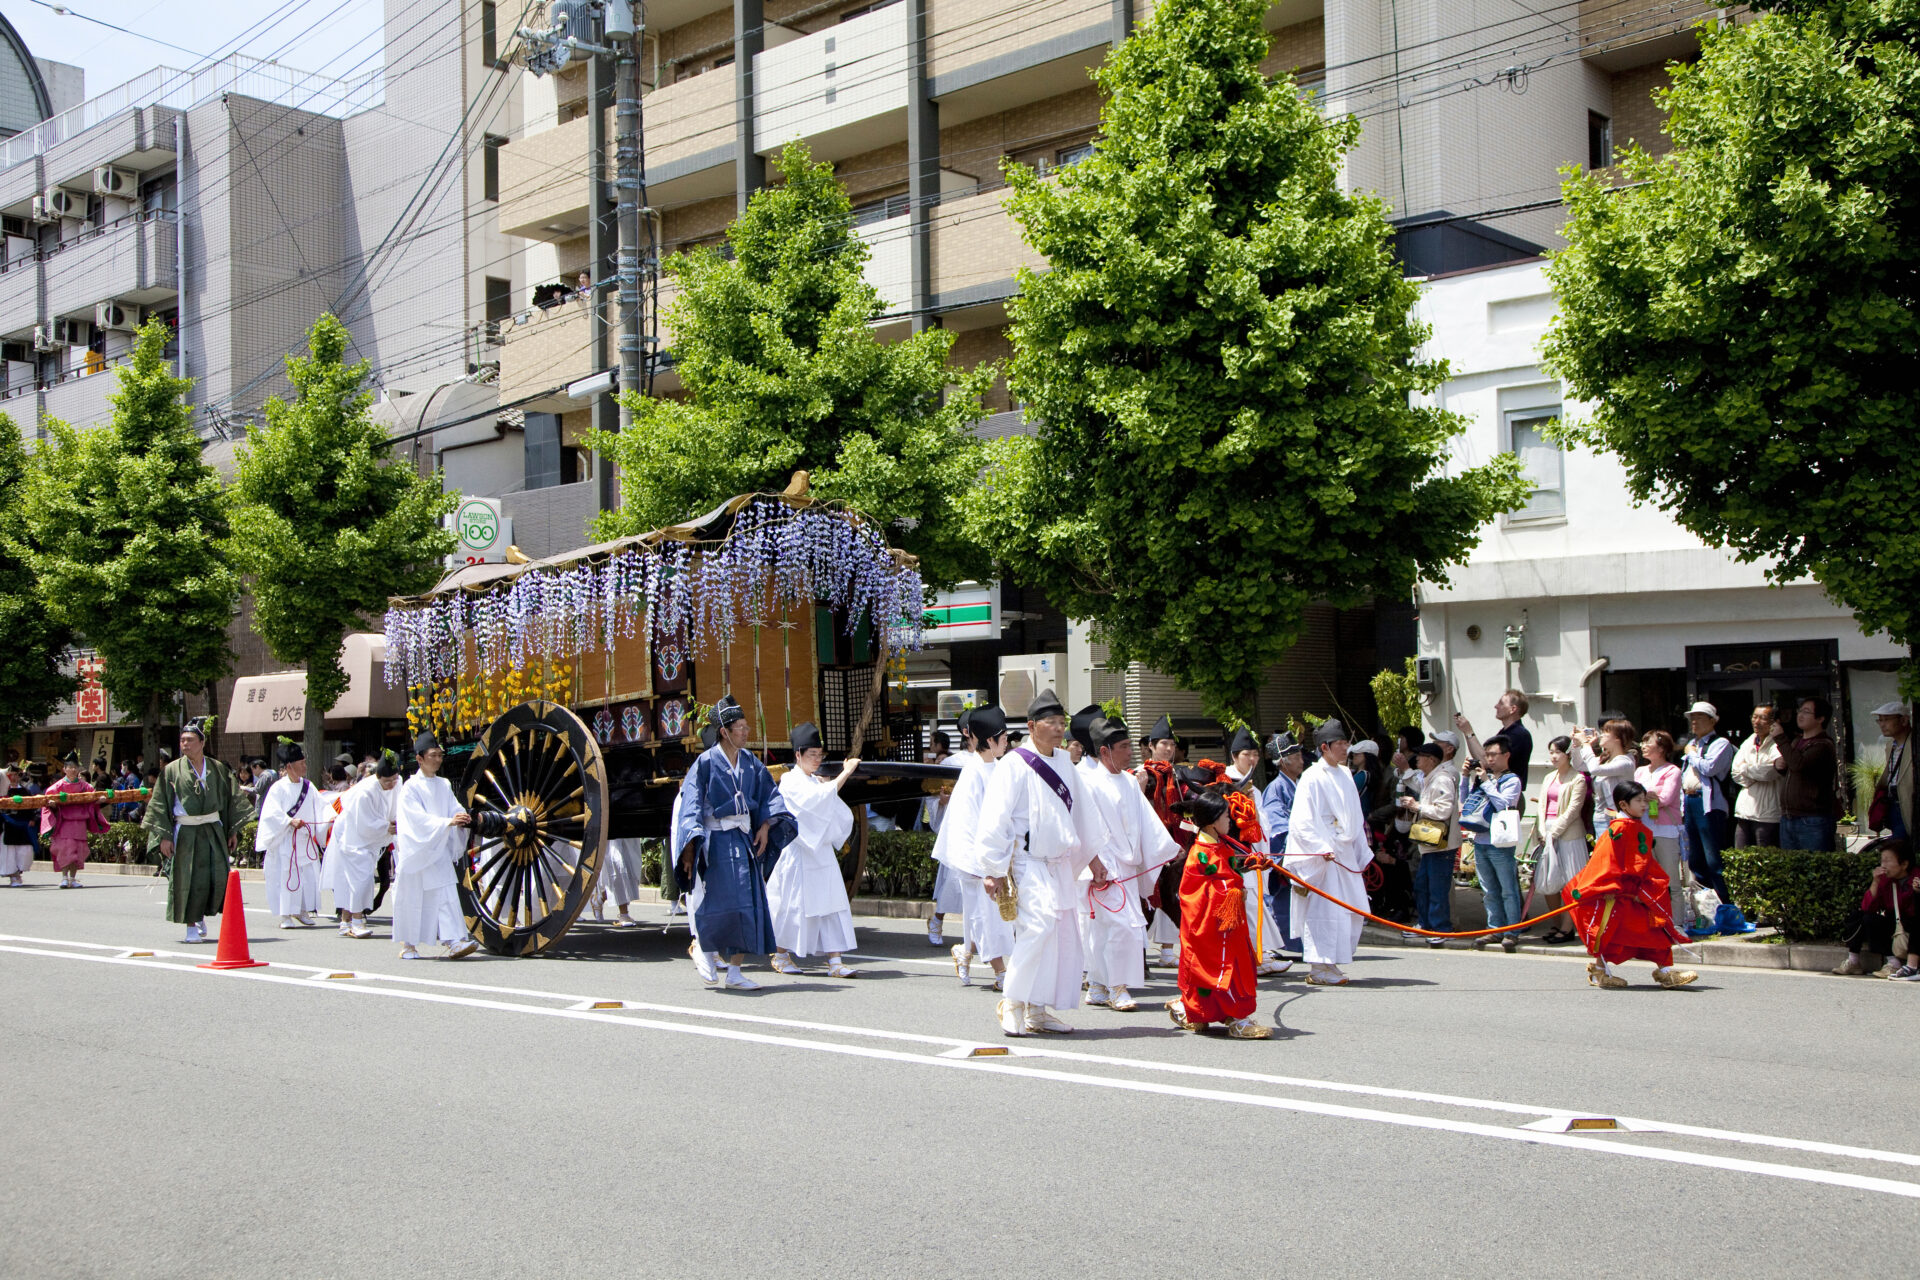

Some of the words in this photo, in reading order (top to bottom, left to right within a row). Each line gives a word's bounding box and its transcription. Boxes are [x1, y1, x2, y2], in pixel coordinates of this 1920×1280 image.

[463, 523, 494, 541] 100
[247, 688, 267, 703] 理容
[272, 706, 303, 722] もりぐち
